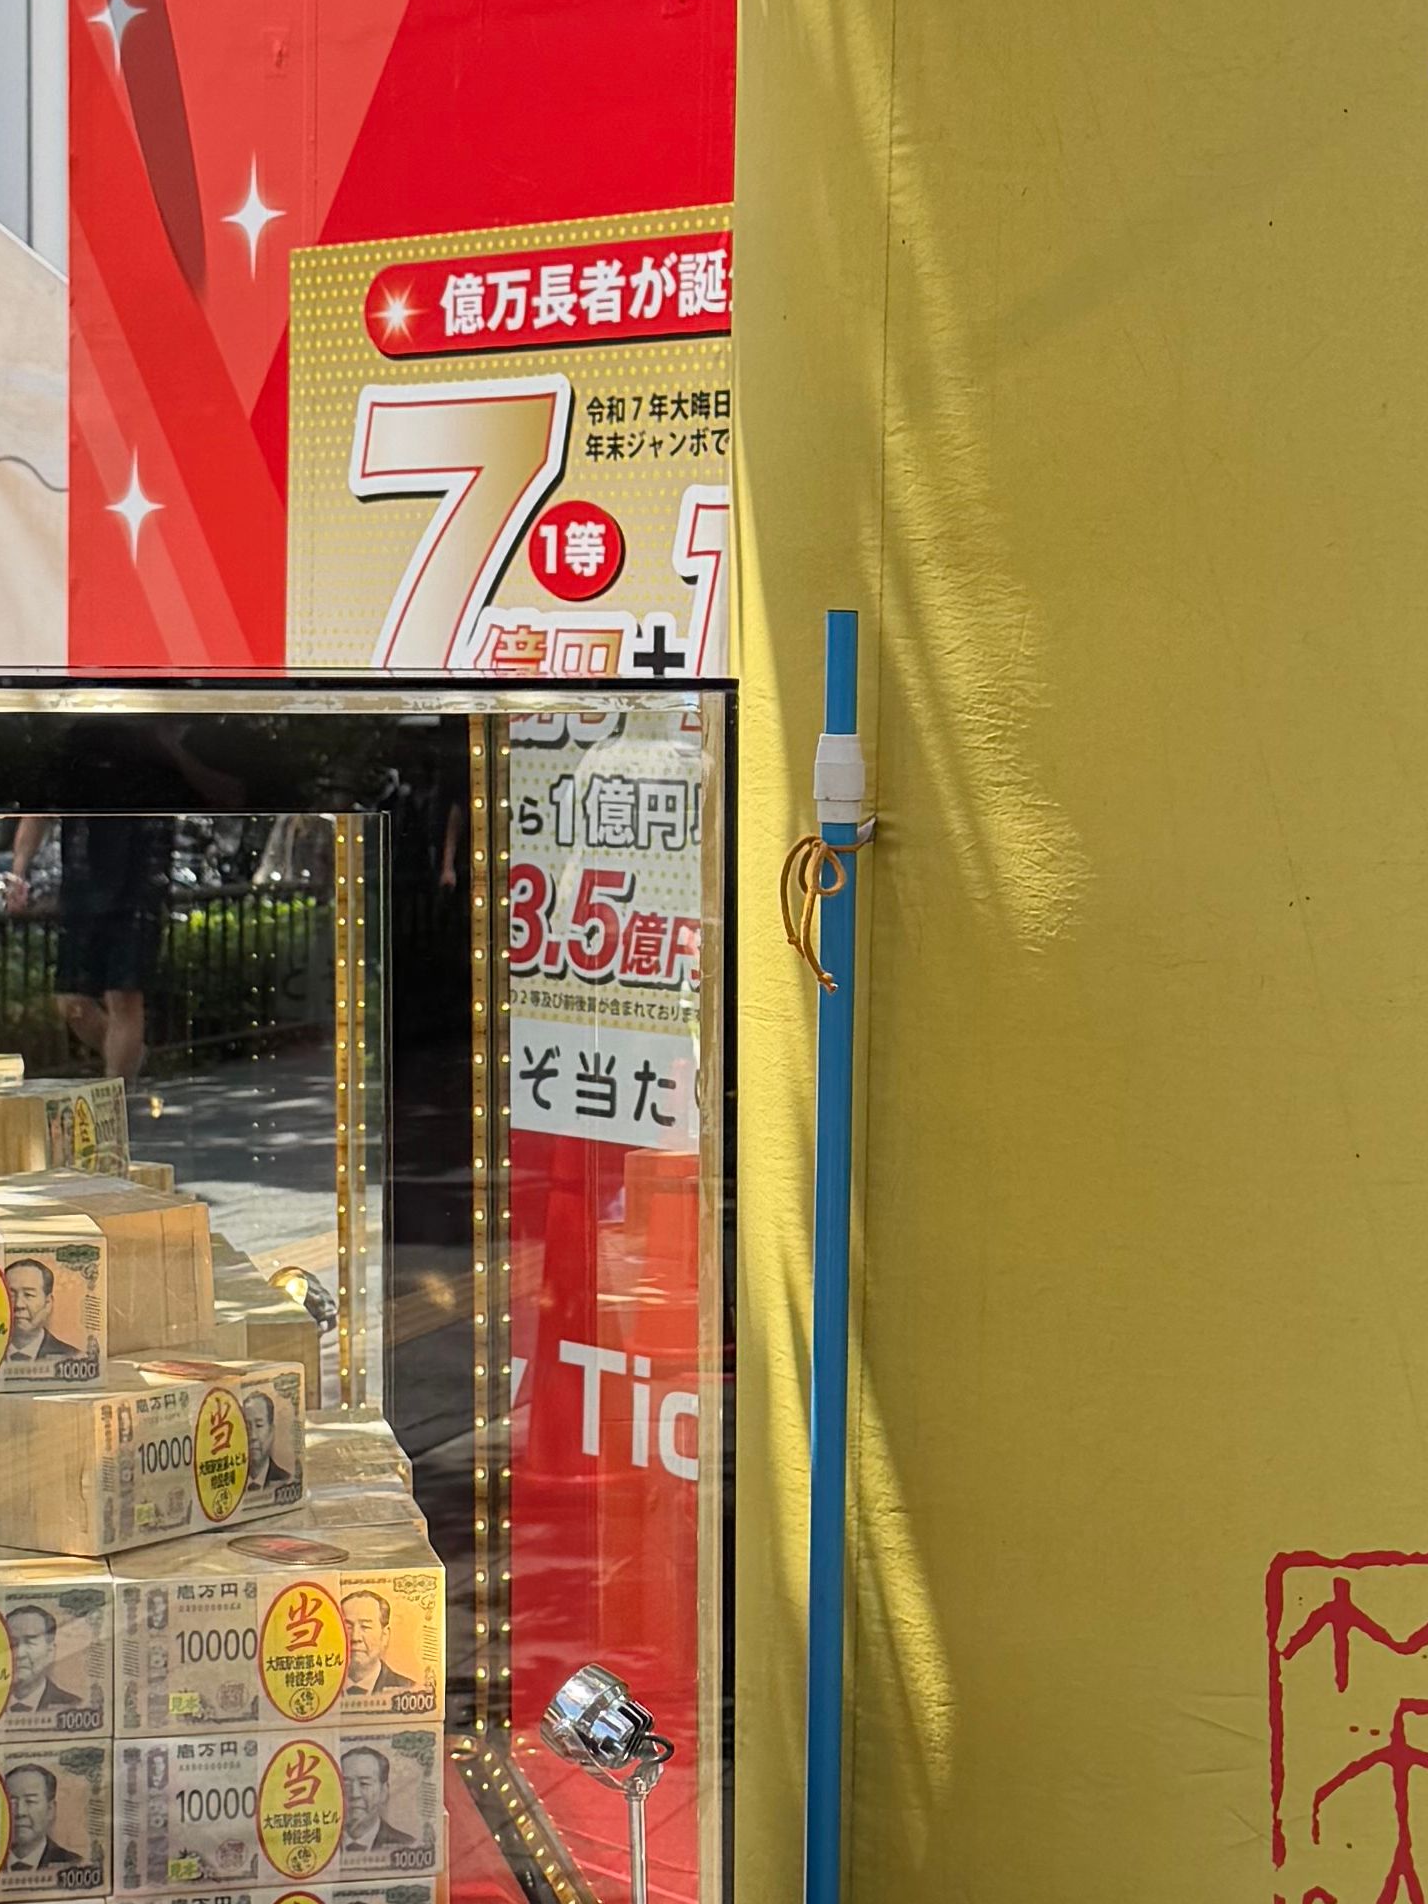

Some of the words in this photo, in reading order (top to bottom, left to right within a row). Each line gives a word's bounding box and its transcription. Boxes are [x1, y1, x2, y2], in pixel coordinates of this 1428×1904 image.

[441, 249, 731, 336] 億万長者が誕
[138, 1435, 192, 1474] 10000
[210, 1398, 233, 1455] 当
[176, 1630, 258, 1664] 10000
[286, 1592, 323, 1651] 当
[176, 1787, 257, 1823] 10000
[283, 1749, 321, 1809] 当
